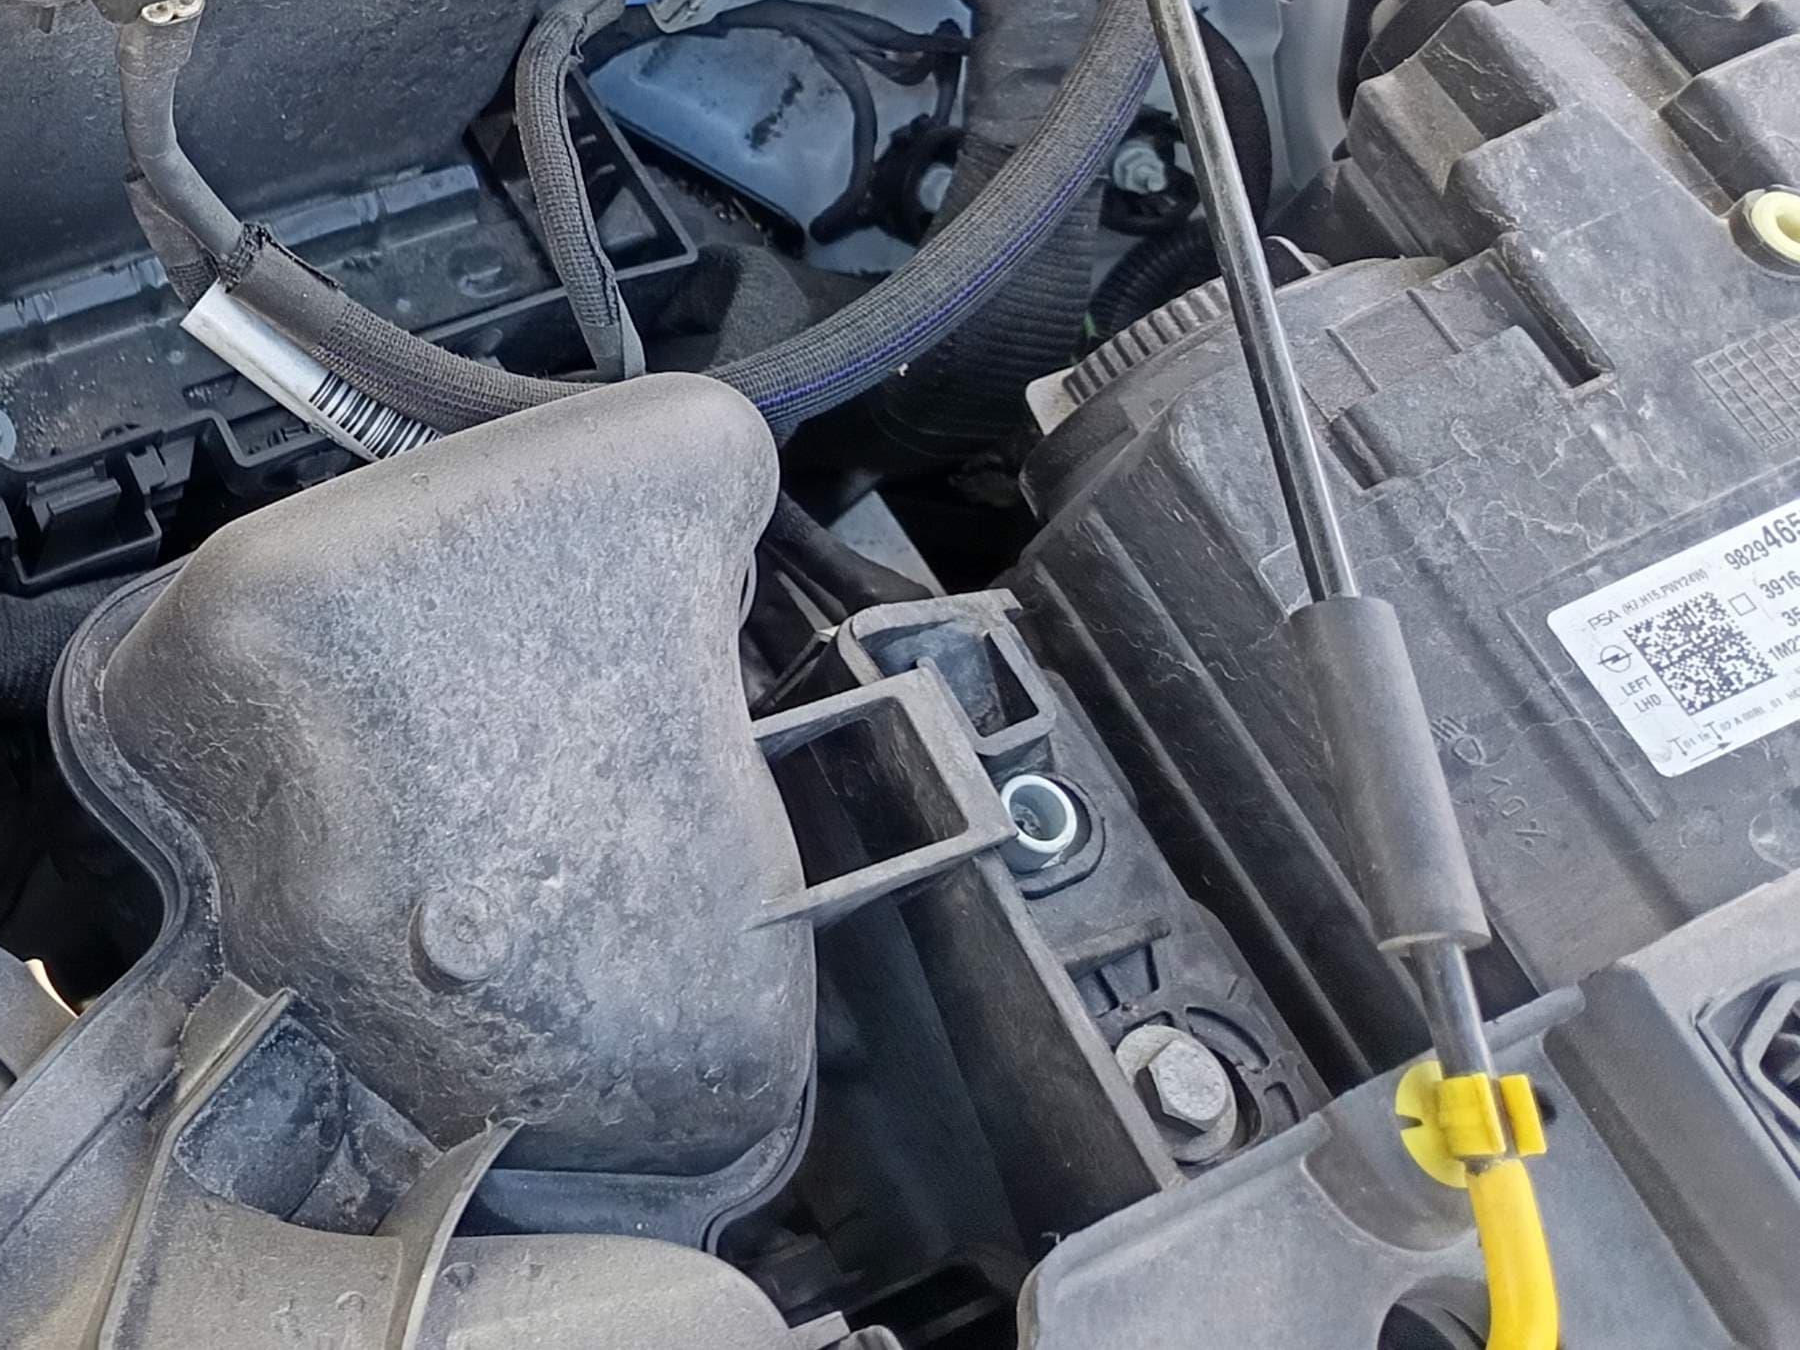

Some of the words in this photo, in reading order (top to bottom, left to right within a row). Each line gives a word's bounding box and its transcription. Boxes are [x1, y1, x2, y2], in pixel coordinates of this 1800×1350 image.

[1759, 570, 1800, 601] 3916
[1587, 609, 1621, 632] PSA
[1620, 675, 1652, 697] LEFT
[1633, 694, 1663, 714] LHD
